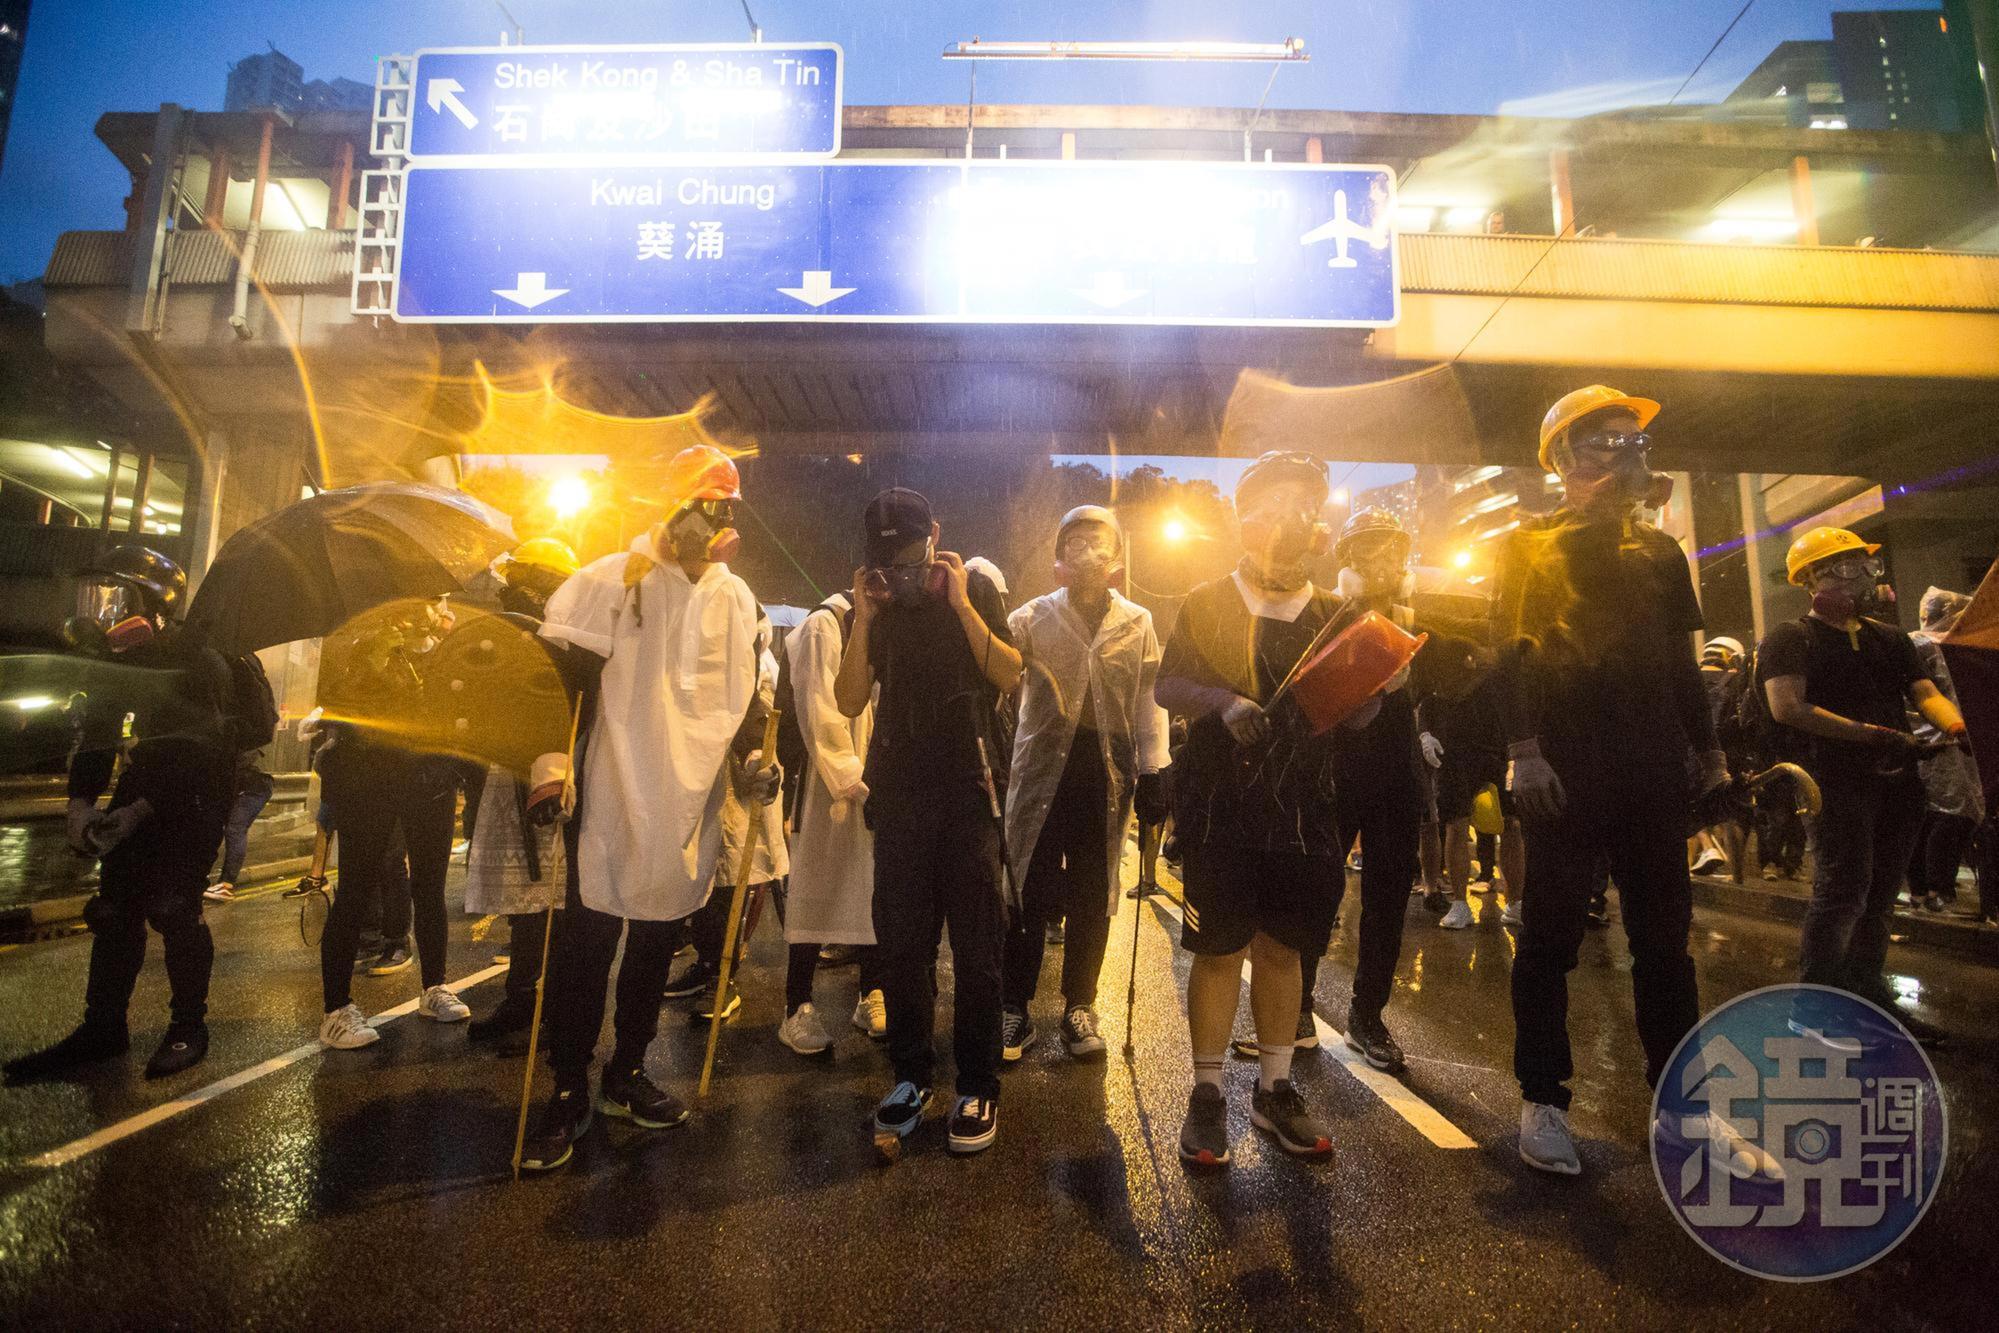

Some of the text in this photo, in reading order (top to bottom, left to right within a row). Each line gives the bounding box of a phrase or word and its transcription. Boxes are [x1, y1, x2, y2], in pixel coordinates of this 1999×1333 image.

[495, 58, 820, 94] Shek Kong & Sha Tin
[591, 177, 775, 211] Kwai Chung
[636, 221, 724, 261] 葵涌
